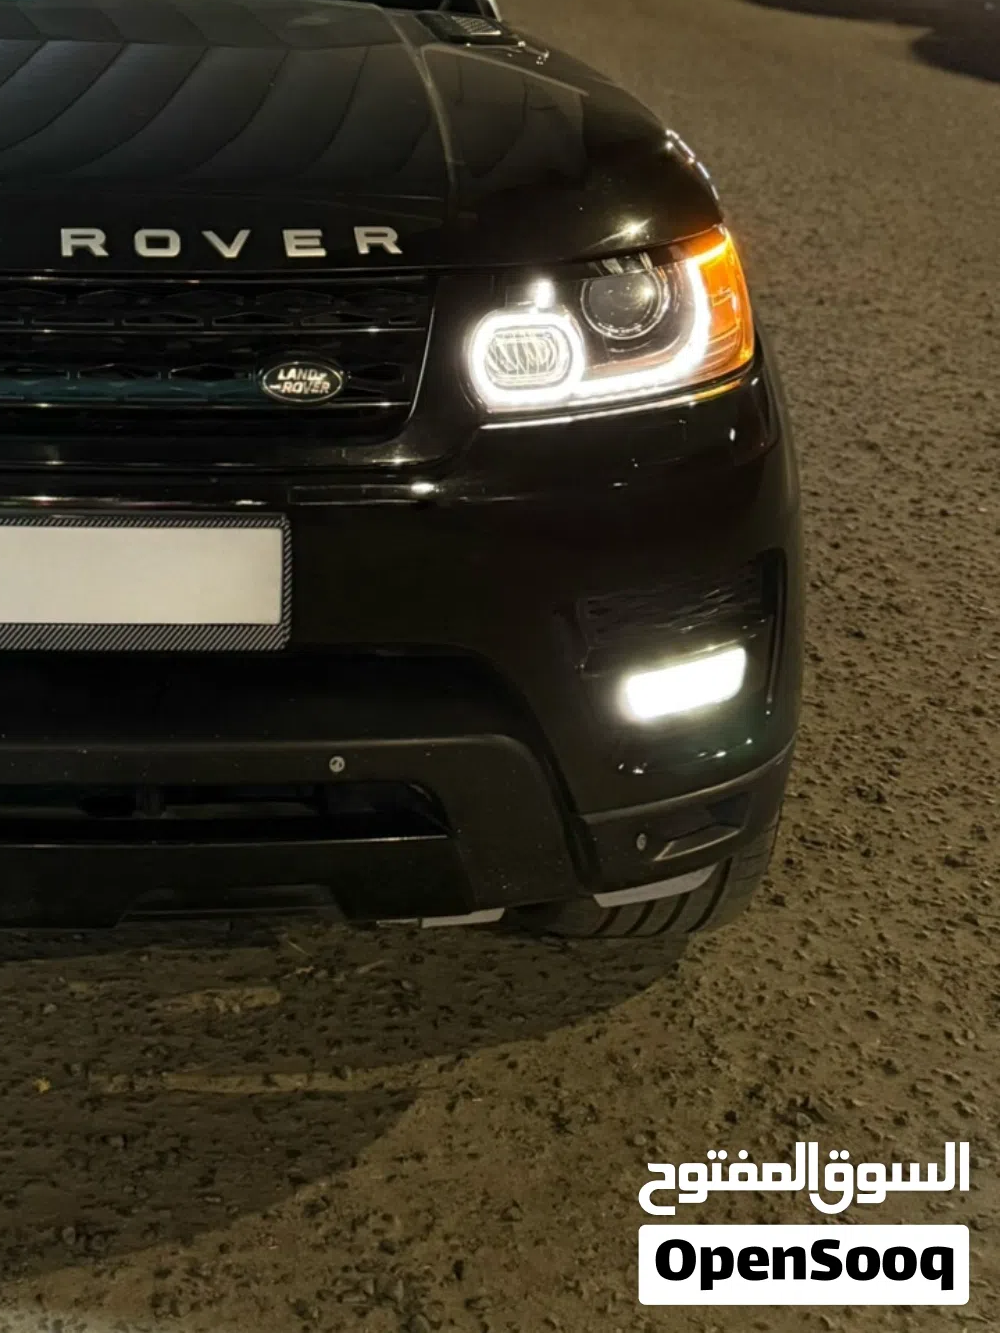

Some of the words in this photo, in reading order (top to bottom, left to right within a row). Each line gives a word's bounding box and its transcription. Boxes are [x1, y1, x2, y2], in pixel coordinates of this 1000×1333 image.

[60, 225, 404, 259] ROVER
[277, 368, 319, 381] LAND
[281, 380, 332, 394] ROVER
